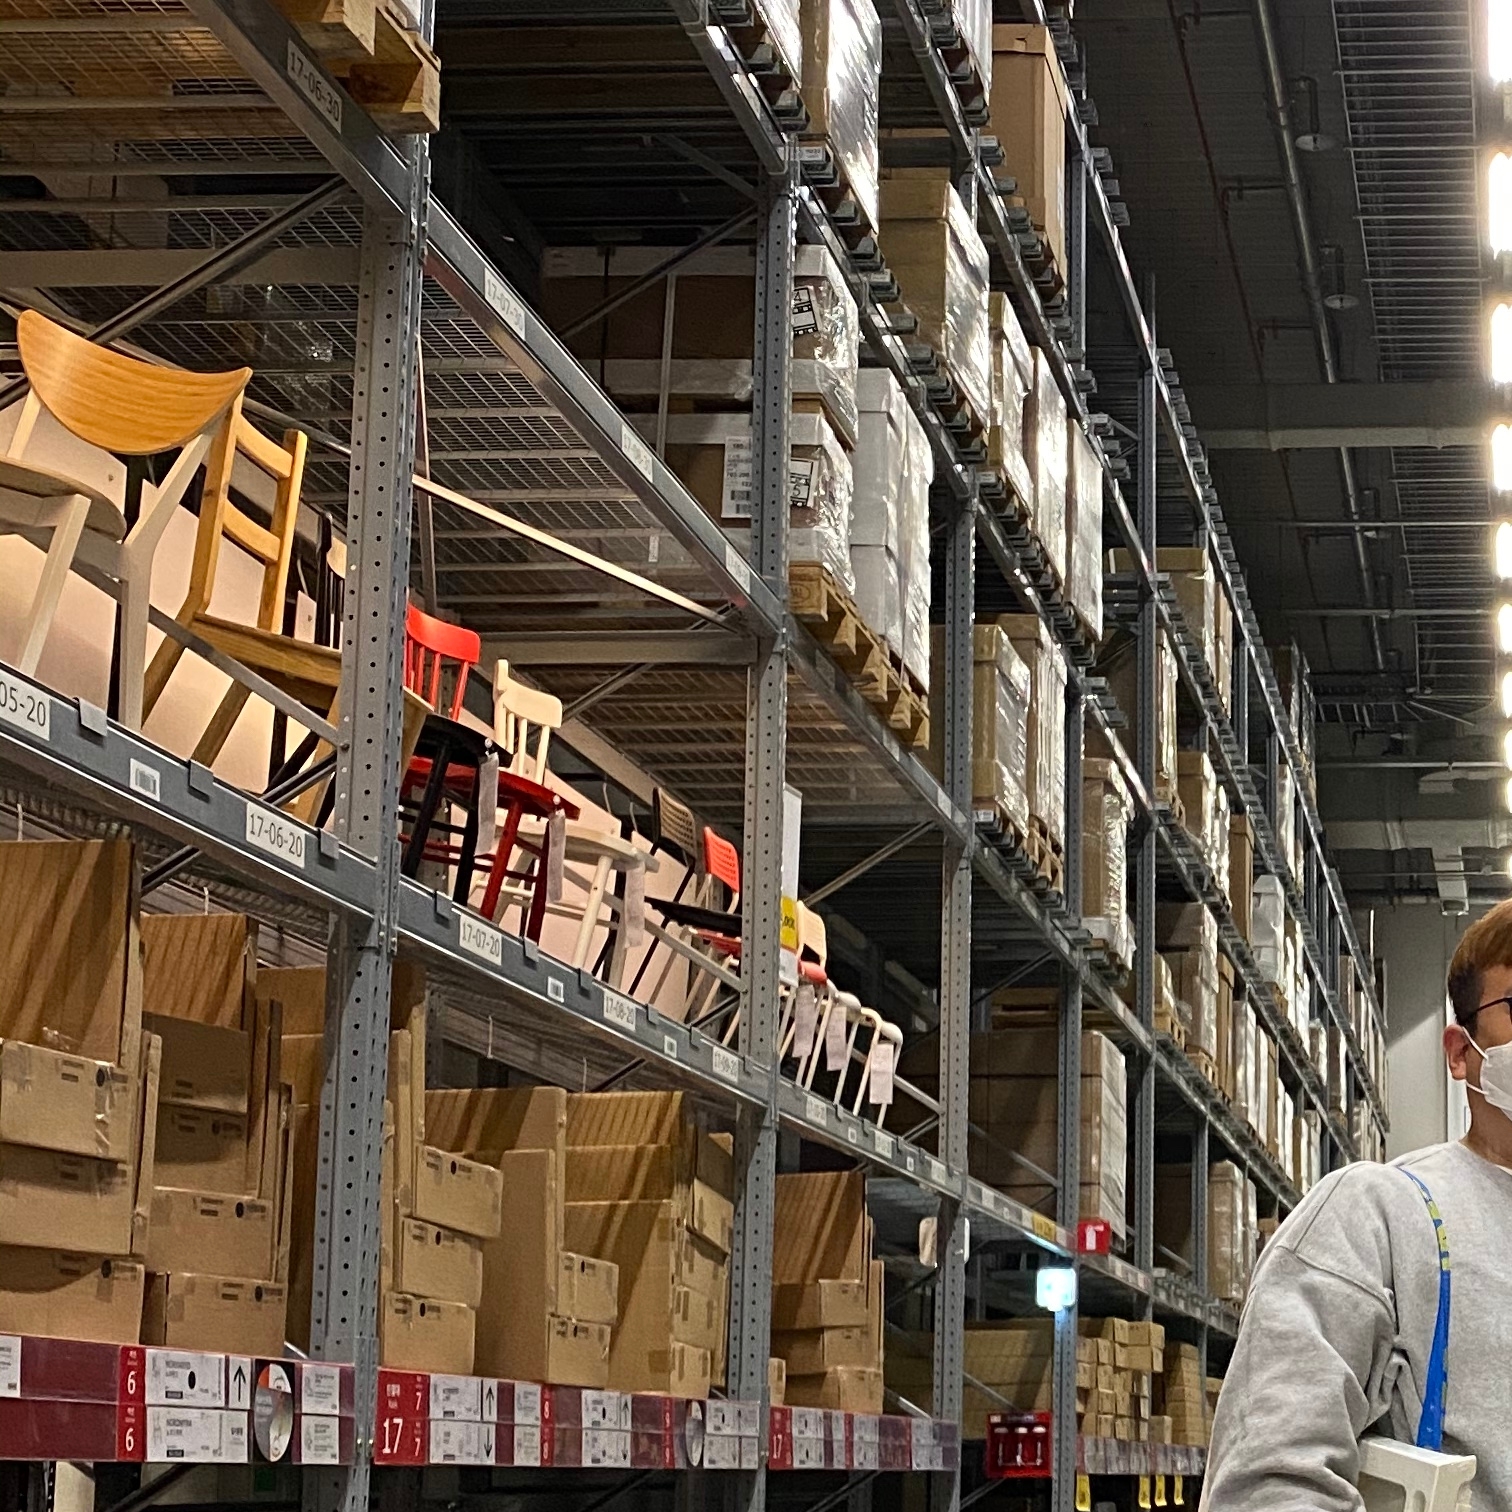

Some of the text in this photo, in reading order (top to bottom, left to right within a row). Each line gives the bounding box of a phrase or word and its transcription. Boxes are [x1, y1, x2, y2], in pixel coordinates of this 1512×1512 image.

[290, 52, 340, 122] 17-06-30
[250, 813, 303, 858] 17-06-20
[462, 922, 500, 957] 17-07-20
[127, 1370, 136, 1395] 6
[415, 1392, 422, 1411] 7
[125, 1427, 134, 1452] 6
[382, 1418, 403, 1454] 17
[414, 1438, 421, 1457] 7
